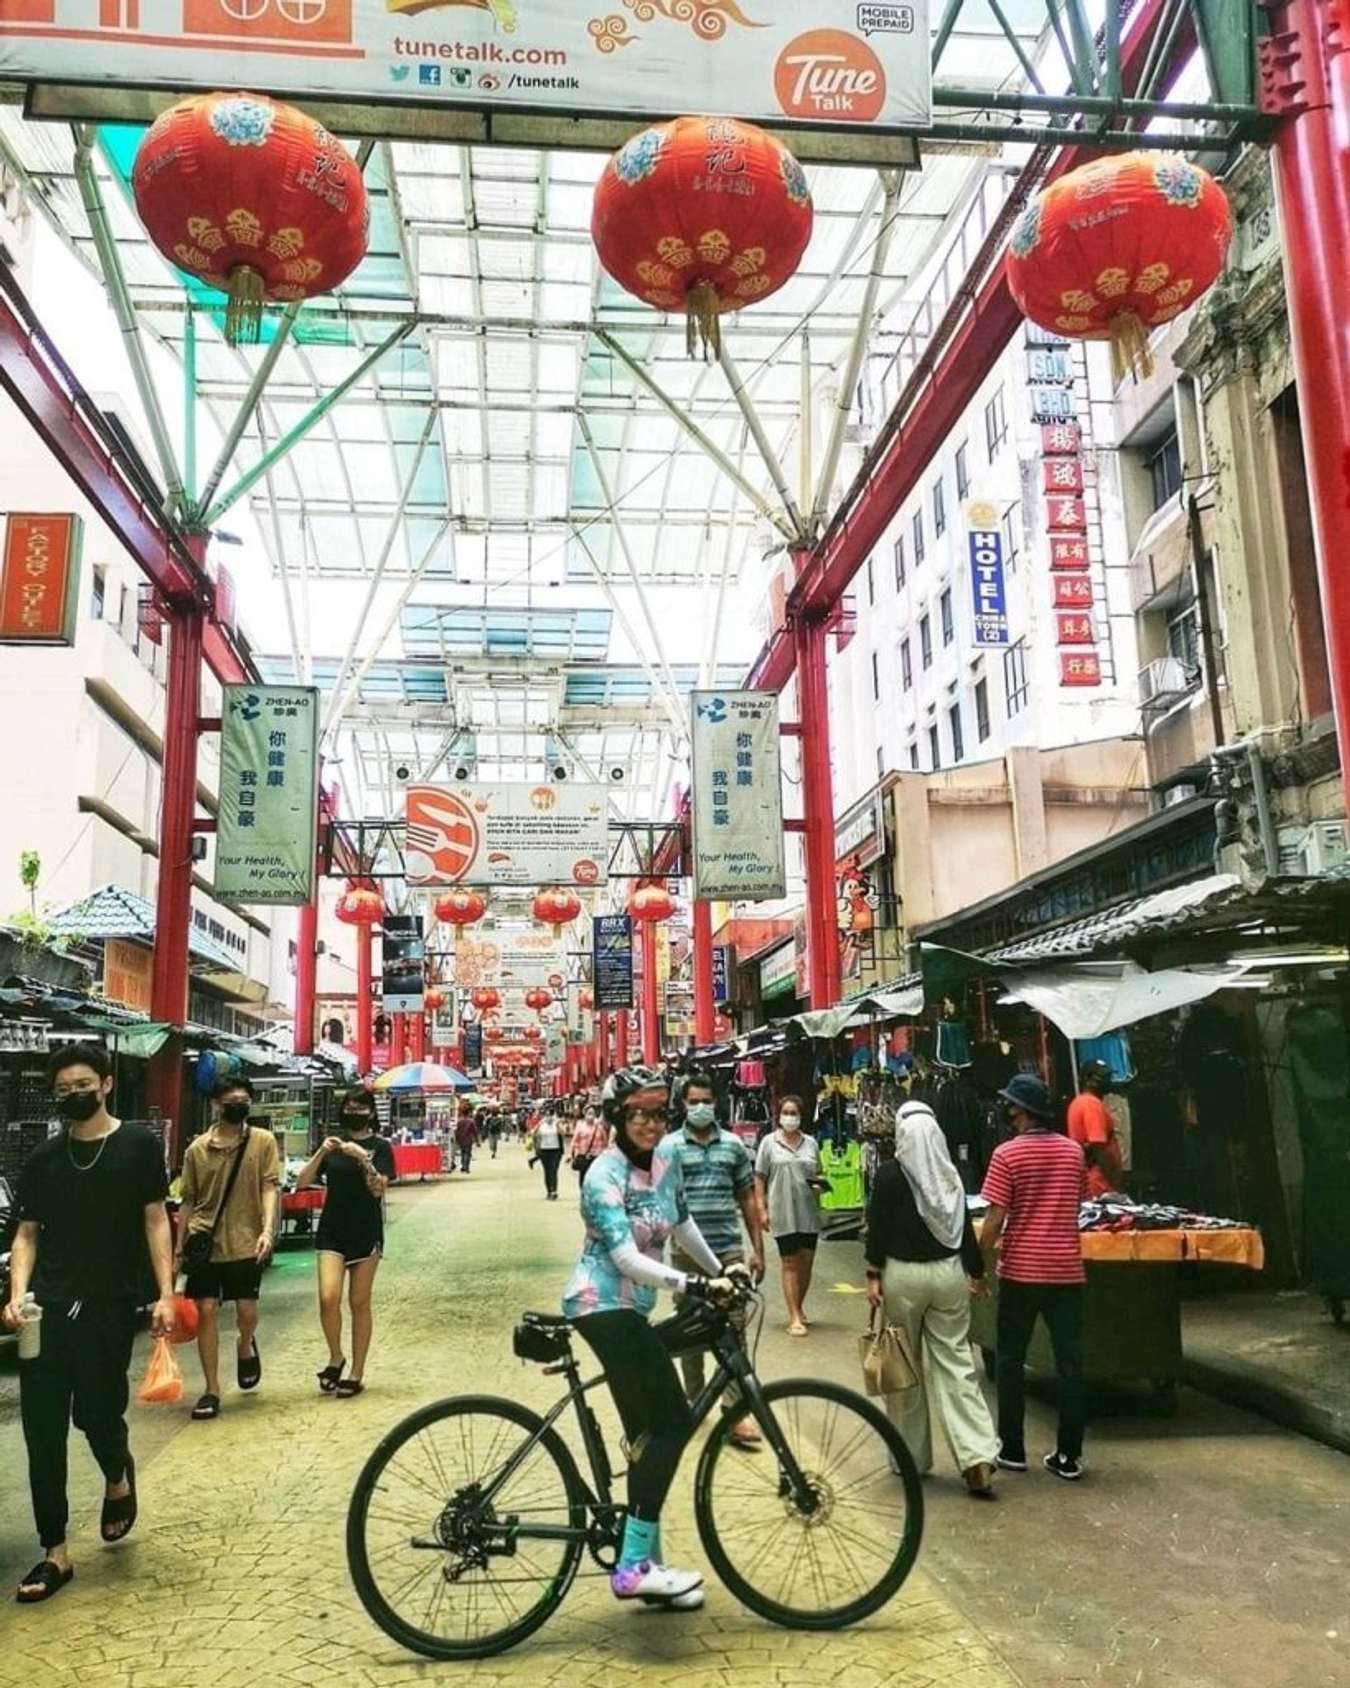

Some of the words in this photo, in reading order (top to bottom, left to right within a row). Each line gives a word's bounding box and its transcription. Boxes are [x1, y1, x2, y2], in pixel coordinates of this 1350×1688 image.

[861, 7, 909, 19] MOBILE
[861, 18, 910, 29] PREPAID
[393, 36, 567, 65] tunetalk.com
[508, 73, 580, 89] /tunetalk
[785, 54, 878, 106] Tune
[810, 94, 853, 111] Talk
[975, 533, 999, 614] HOTEL
[266, 731, 286, 787] 你健康
[736, 732, 753, 786] 你健康
[237, 770, 257, 827] 我自豪
[712, 771, 729, 826] 我自豪
[218, 855, 242, 865] Your
[245, 855, 285, 866] Health,
[699, 852, 721, 862] Your
[724, 851, 761, 862] Health,
[249, 869, 265, 880] My
[728, 864, 744, 875] My
